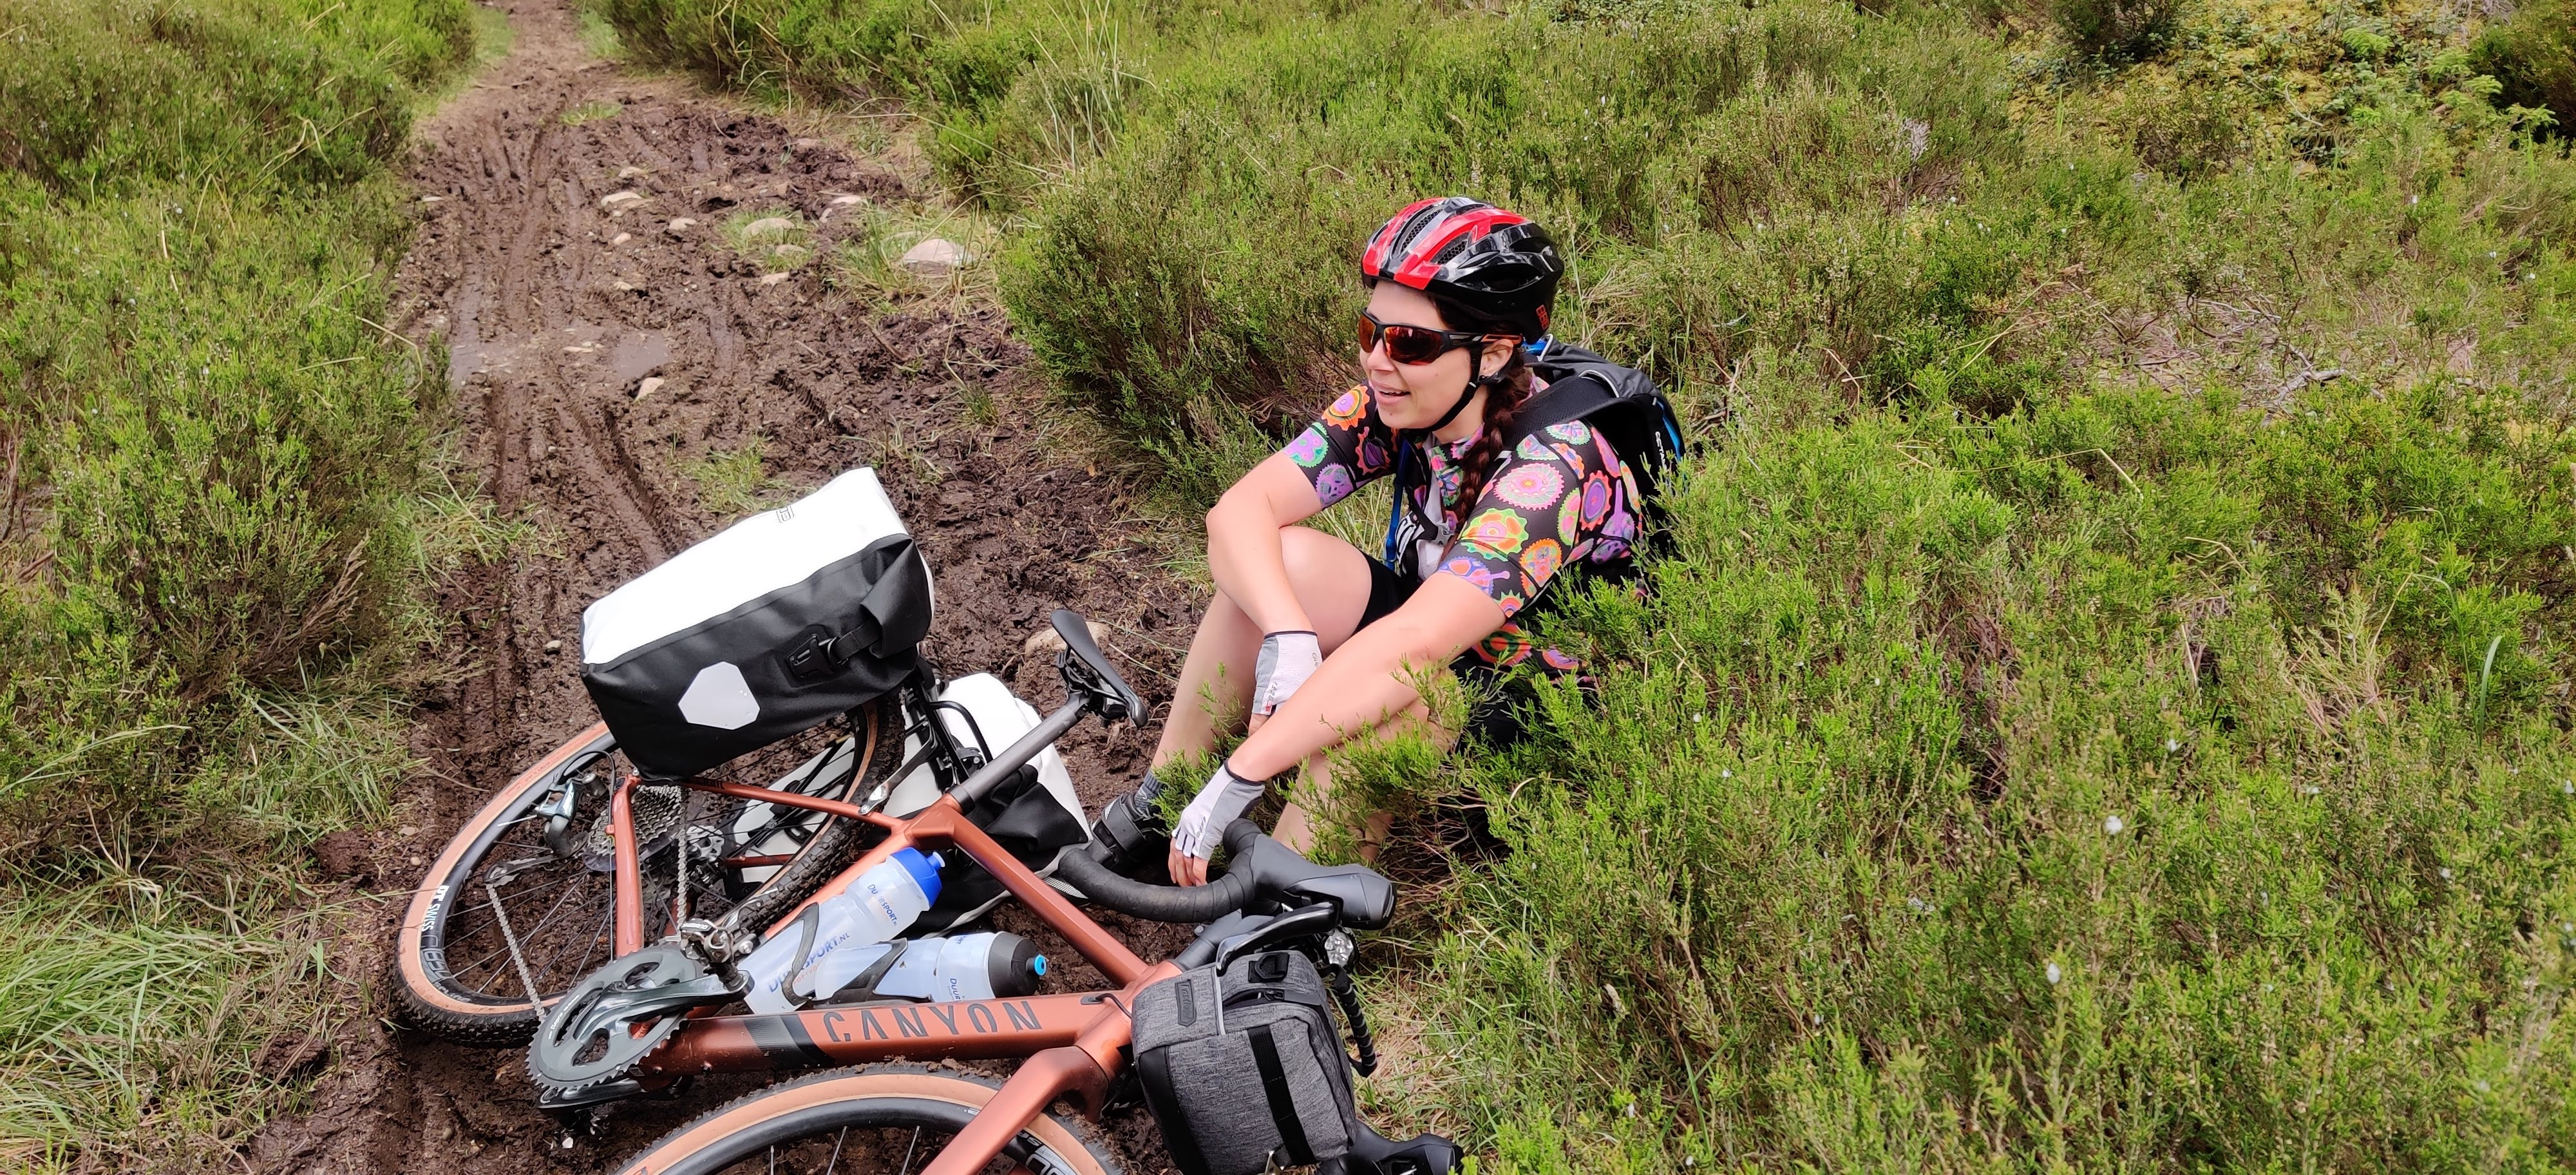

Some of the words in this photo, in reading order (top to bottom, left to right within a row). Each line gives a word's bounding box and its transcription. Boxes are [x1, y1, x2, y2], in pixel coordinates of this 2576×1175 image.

[1536, 304, 1549, 330] BBB
[433, 885, 450, 902] DT
[422, 904, 440, 932] SWISS
[823, 1001, 1043, 1042] CANYON
